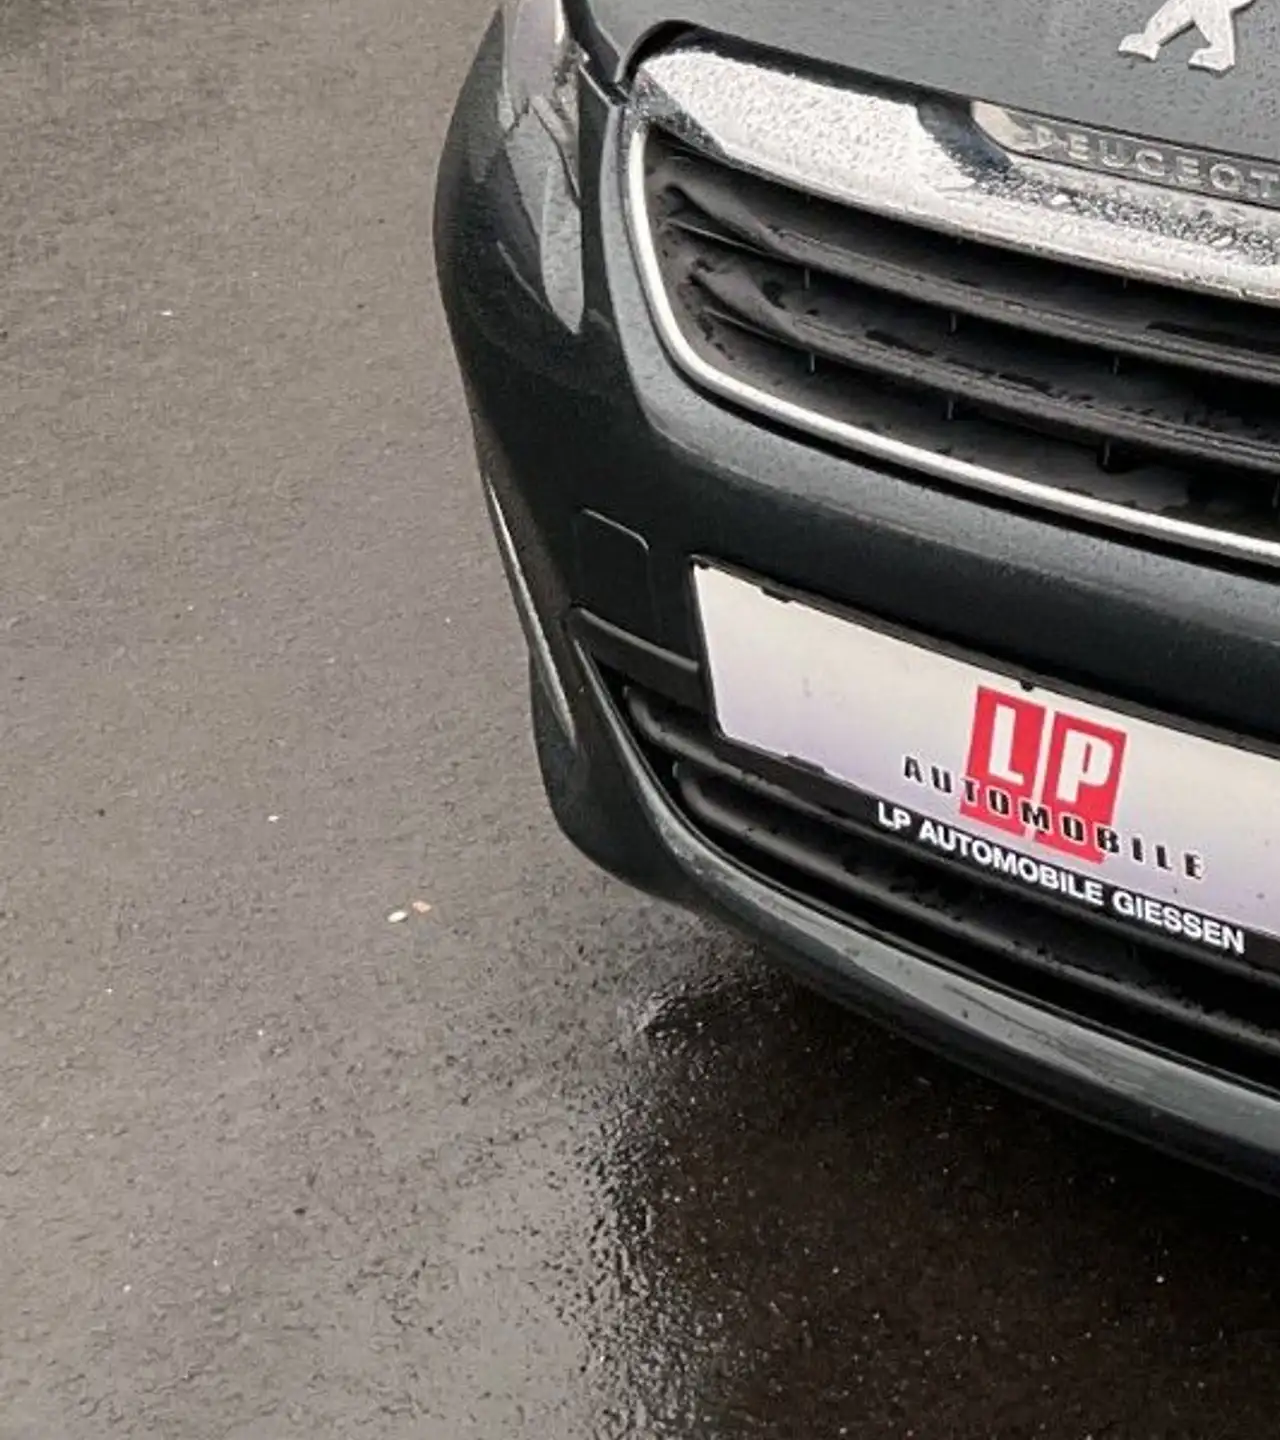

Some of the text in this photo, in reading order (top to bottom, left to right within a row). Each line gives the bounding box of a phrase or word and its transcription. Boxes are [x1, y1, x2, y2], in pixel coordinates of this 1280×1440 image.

[1033, 123, 1280, 198] PEUGEOT
[988, 703, 1114, 803] LP
[903, 755, 1204, 879] AUTOMOBILE
[878, 801, 1245, 955] LP AUTOMOBILE GIESSEN
